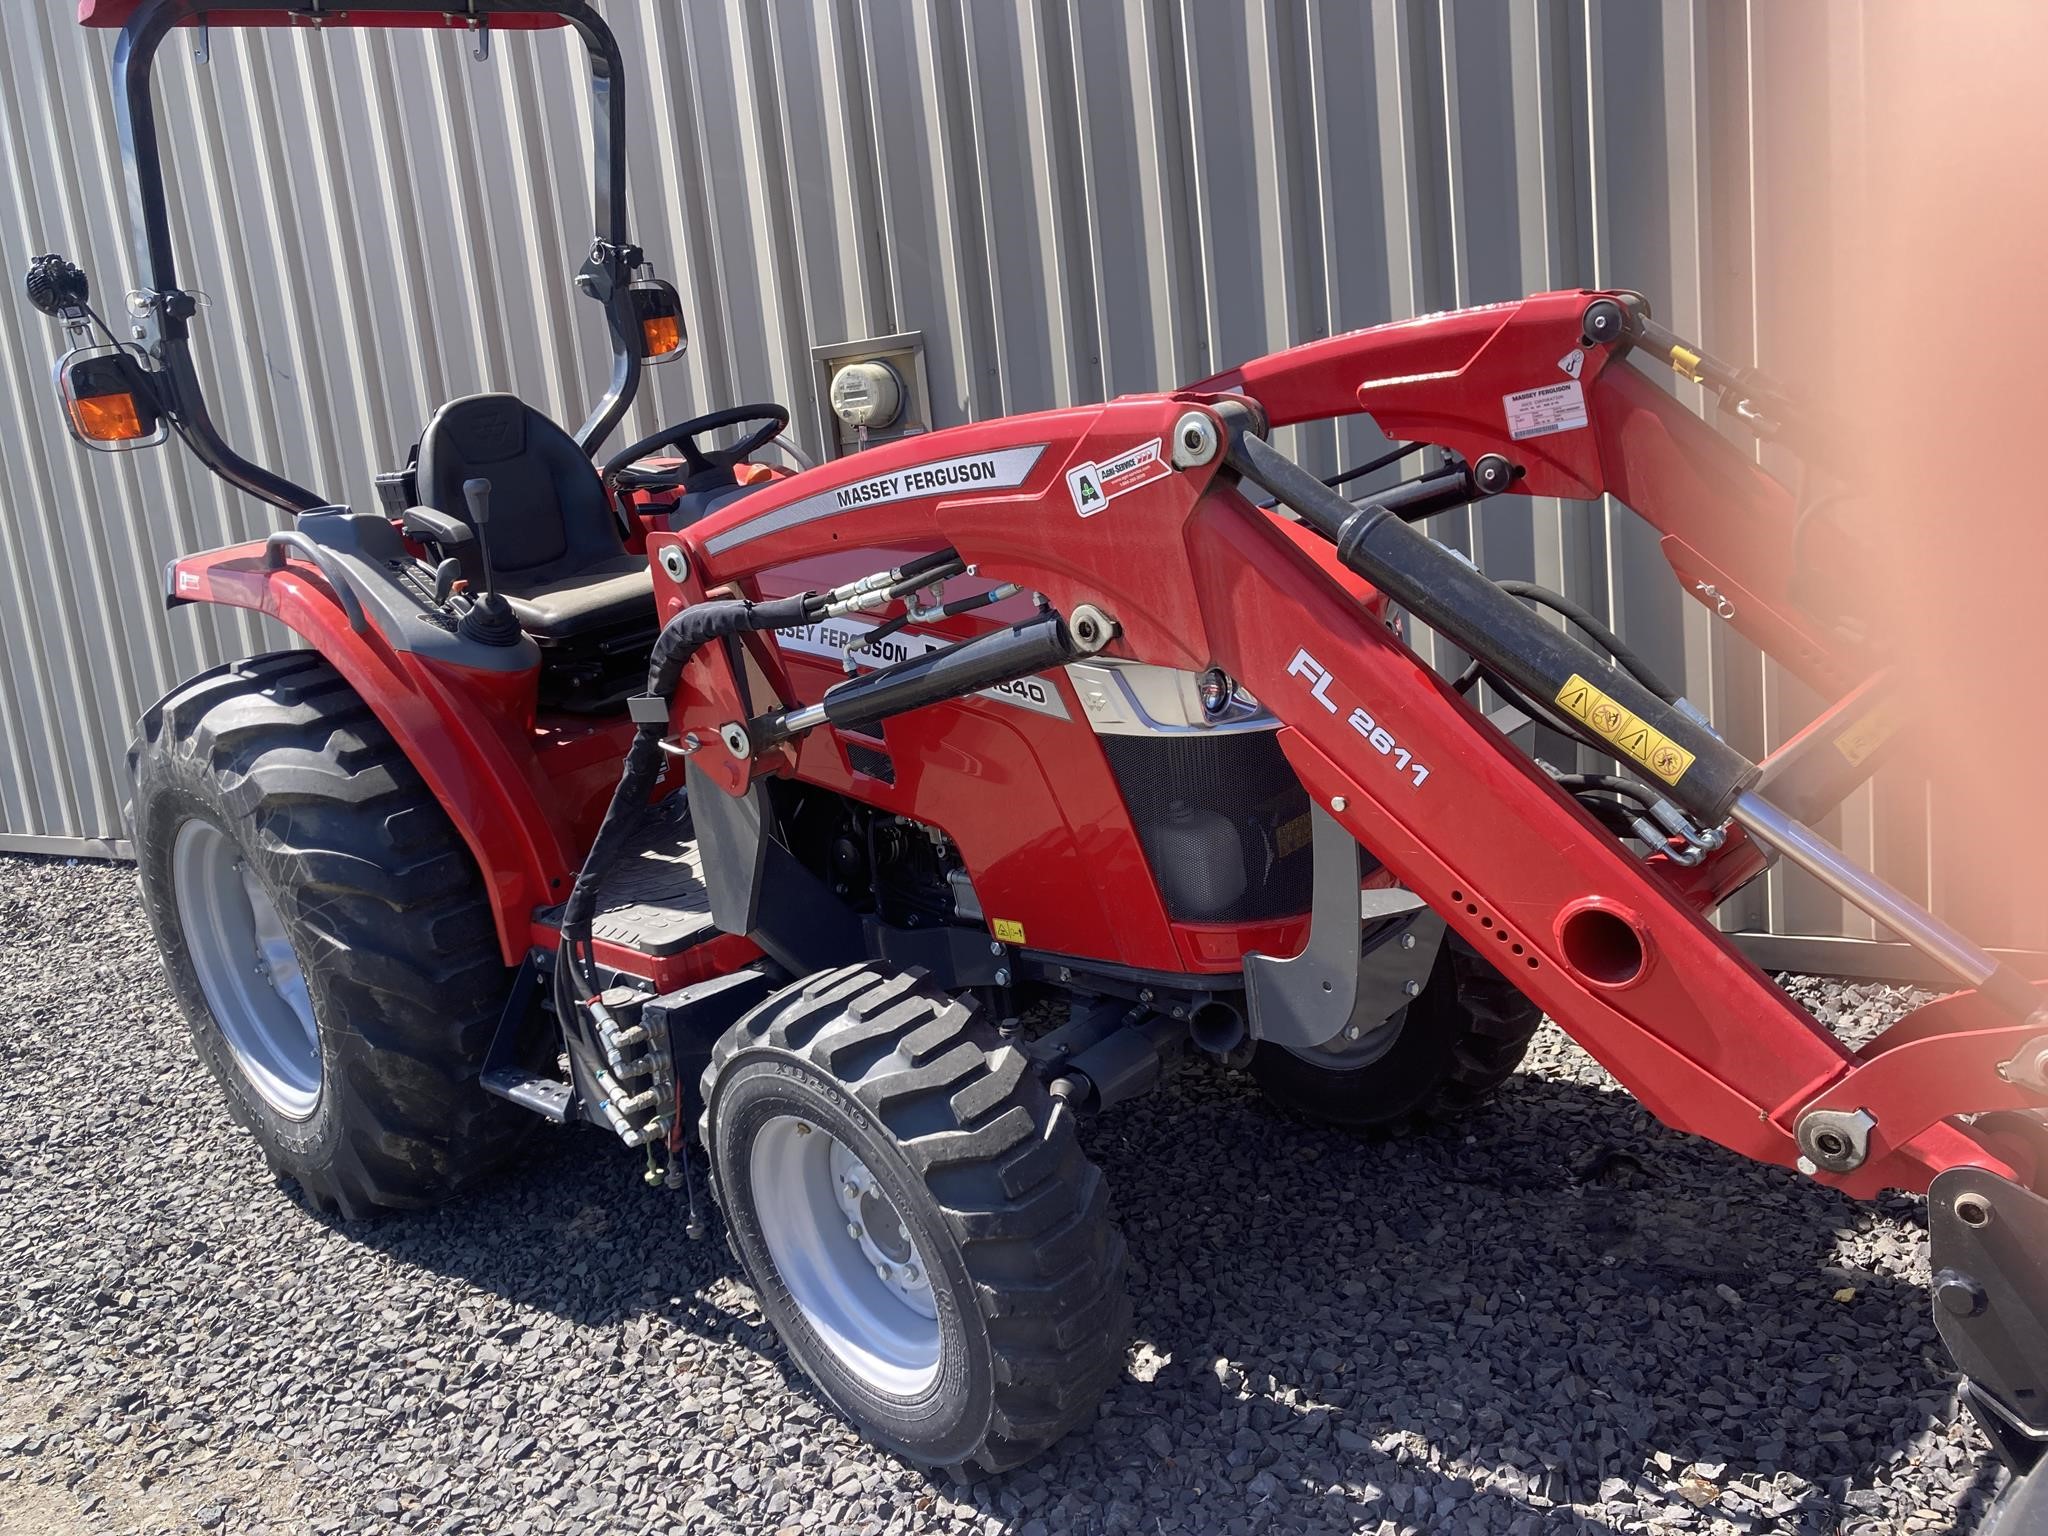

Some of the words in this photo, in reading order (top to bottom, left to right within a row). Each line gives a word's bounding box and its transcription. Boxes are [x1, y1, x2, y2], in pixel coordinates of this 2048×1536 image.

[1512, 391, 1537, 402] MASSEY
[1538, 384, 1572, 396] FERGUSON
[836, 477, 899, 508] MASSEY
[904, 460, 997, 492] FERGUSON
[1286, 648, 1339, 715] FL
[1347, 706, 1431, 788] 2611
